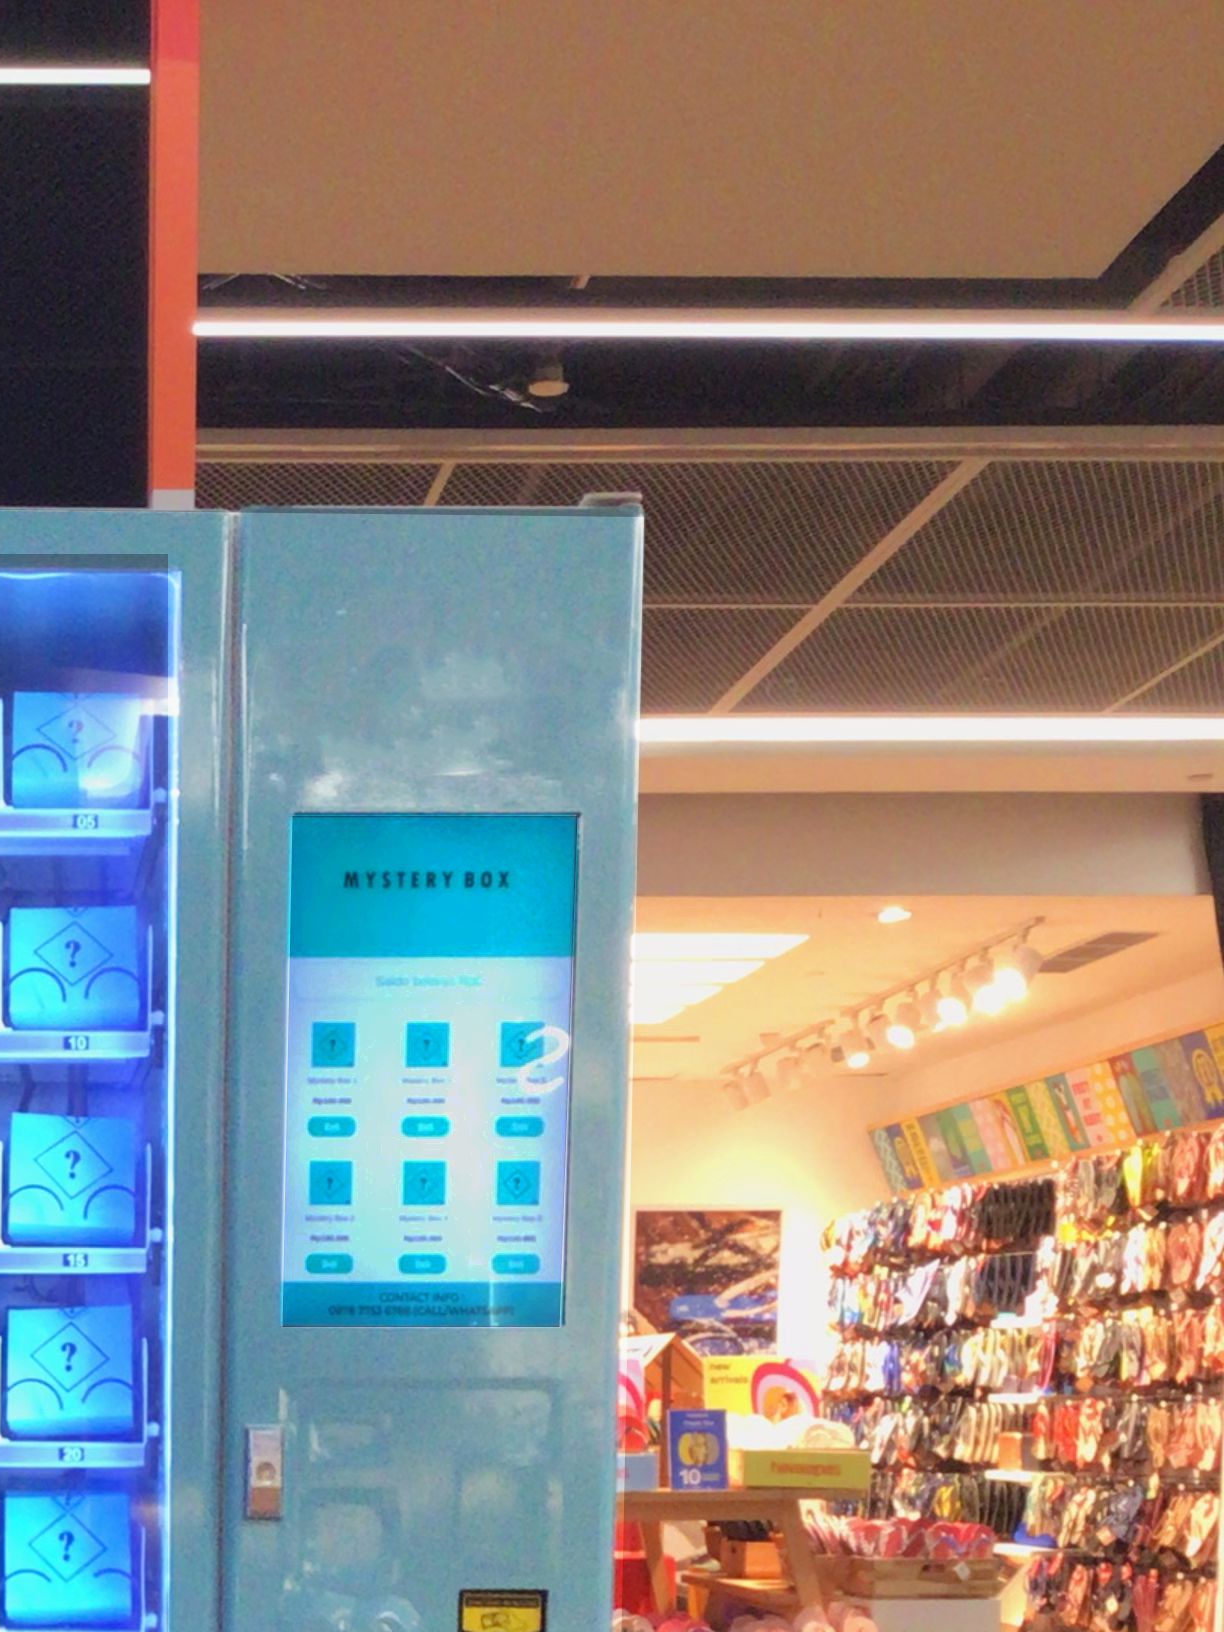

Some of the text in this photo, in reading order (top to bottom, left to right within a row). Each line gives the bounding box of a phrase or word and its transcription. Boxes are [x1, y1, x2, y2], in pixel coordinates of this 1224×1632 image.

[76, 814, 96, 829] 05
[343, 871, 510, 889] MYSTERY BOX
[67, 1036, 87, 1051] 10
[66, 1253, 85, 1268] 15
[63, 1447, 82, 1462] 20
[679, 1468, 701, 1485] 10
